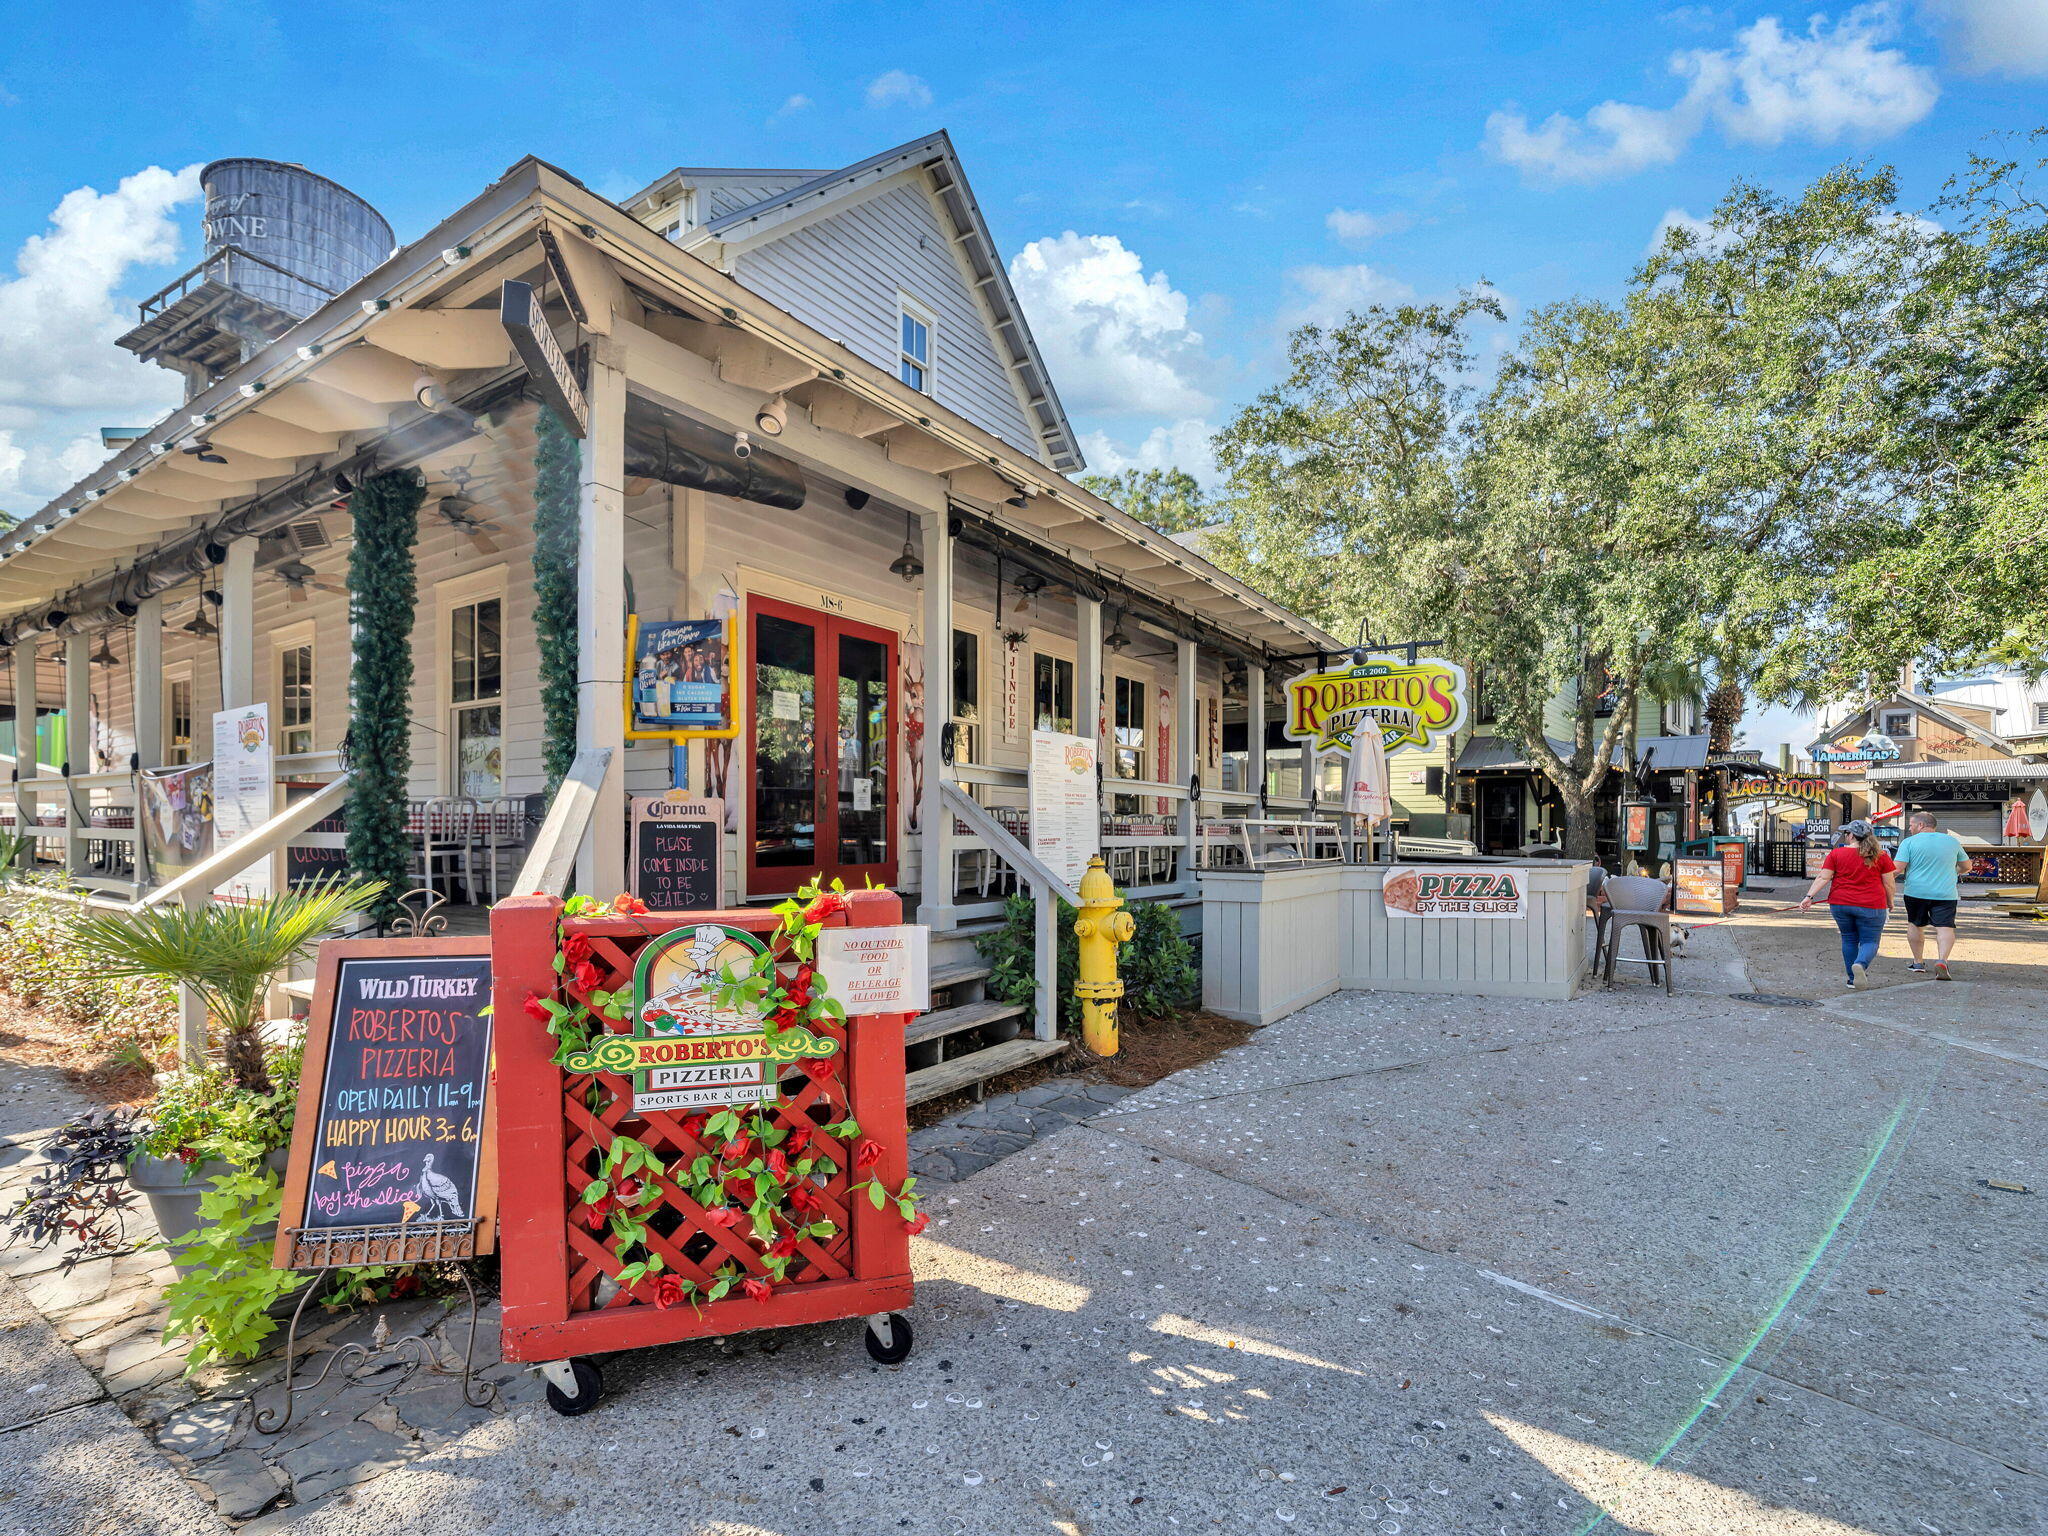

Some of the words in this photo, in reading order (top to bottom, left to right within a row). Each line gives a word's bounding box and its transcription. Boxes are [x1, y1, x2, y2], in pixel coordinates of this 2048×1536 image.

[821, 595, 843, 612] MS-6
[1369, 667, 1388, 675] 2002
[1295, 674, 1452, 731] ROBERTO'S
[1774, 779, 1828, 807] DOOR
[1936, 783, 2008, 792] OYSTER
[1953, 791, 1989, 800] BAR
[647, 801, 707, 819] Corona
[655, 837, 693, 852] PLEASE
[643, 857, 672, 874] COME
[675, 857, 709, 873] INSIDE
[1679, 867, 1705, 877] BBQ
[656, 876, 671, 889] TO
[677, 876, 692, 890] BE
[1418, 874, 1519, 900] PIZZA
[648, 890, 696, 907] SEATED
[1416, 902, 1437, 912] BY
[1439, 901, 1469, 912] THE
[1473, 901, 1518, 912] SLICE
[843, 941, 858, 950] NO
[860, 939, 904, 949] OUTSIDE
[860, 952, 889, 962] FOOD
[867, 966, 882, 975] OR
[359, 978, 409, 1000] WILD
[848, 978, 901, 989] BEVERAGE
[851, 990, 900, 1001] ALLOWED
[349, 1007, 463, 1045] ROBERTO'S
[638, 1038, 772, 1064] ROBERTO'S
[361, 1047, 455, 1080] PIZZERIA
[659, 1066, 754, 1085] PIZZERIA
[338, 1087, 379, 1113] OPEN
[383, 1084, 432, 1110] DAILY
[640, 1093, 689, 1106] SPORTS
[693, 1091, 718, 1101] BAR
[723, 1091, 732, 1099] &
[737, 1088, 771, 1099] GRILL
[326, 1118, 381, 1147] HAPPY
[385, 1115, 432, 1144] HOUR
[341, 1161, 410, 1190] pizza
[314, 1190, 341, 1216] by
[343, 1188, 373, 1209] the
[373, 1186, 422, 1204] slice
